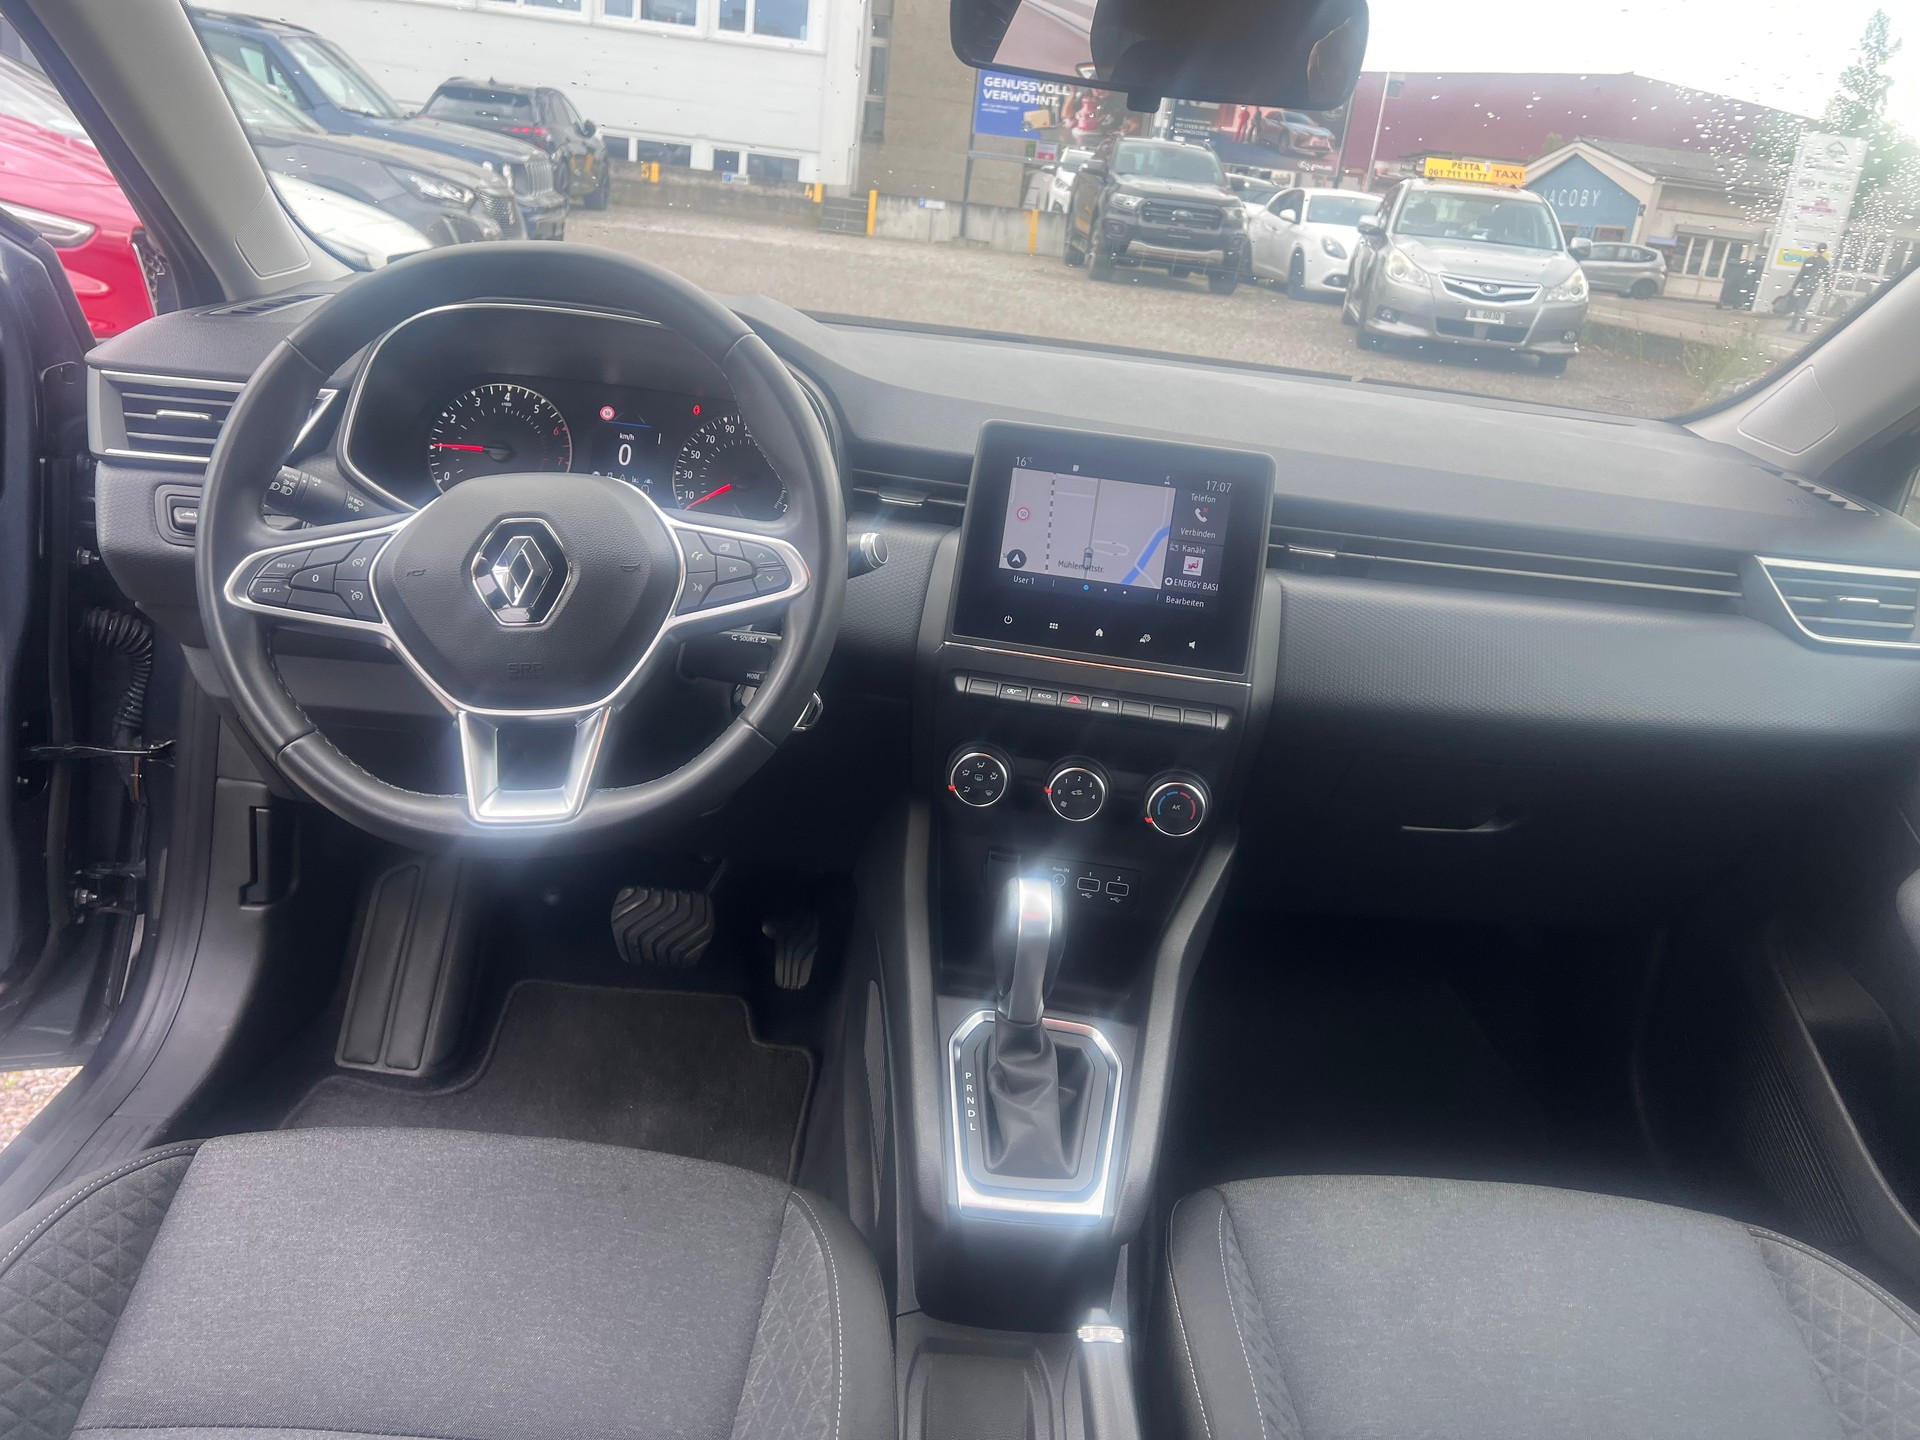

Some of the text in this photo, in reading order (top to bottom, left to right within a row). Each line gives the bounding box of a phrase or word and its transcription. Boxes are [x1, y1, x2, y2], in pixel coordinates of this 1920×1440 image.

[983, 89, 1060, 107] VERWÖHNT.
[1428, 168, 1444, 176] 061
[1446, 170, 1461, 178] 711
[1452, 162, 1523, 180] PETTA TAXI
[474, 398, 481, 406] 3
[504, 392, 510, 402] 4
[534, 404, 540, 414] 5
[450, 414, 456, 424] 2
[553, 426, 559, 436] 6
[724, 425, 736, 434] 90
[620, 432, 634, 440] km/h
[705, 434, 716, 444] 70
[618, 443, 632, 466] 0
[690, 450, 700, 460] 50
[283, 472, 299, 481] AUTO
[444, 471, 450, 480] 0
[682, 470, 692, 480] 30
[1206, 480, 1232, 493] 17:07
[684, 490, 694, 500] 10
[1192, 493, 1216, 504] Telefon
[1180, 528, 1216, 538] Verbinden
[1182, 544, 1206, 555] Kanäle
[1013, 576, 1029, 584] User
[1174, 578, 1202, 589] ENERGY
[1166, 596, 1205, 608] Bearbeiten
[740, 634, 759, 644] SOURCE
[746, 672, 760, 680] MODE
[967, 1096, 975, 1105] N
[970, 1123, 976, 1131] L
